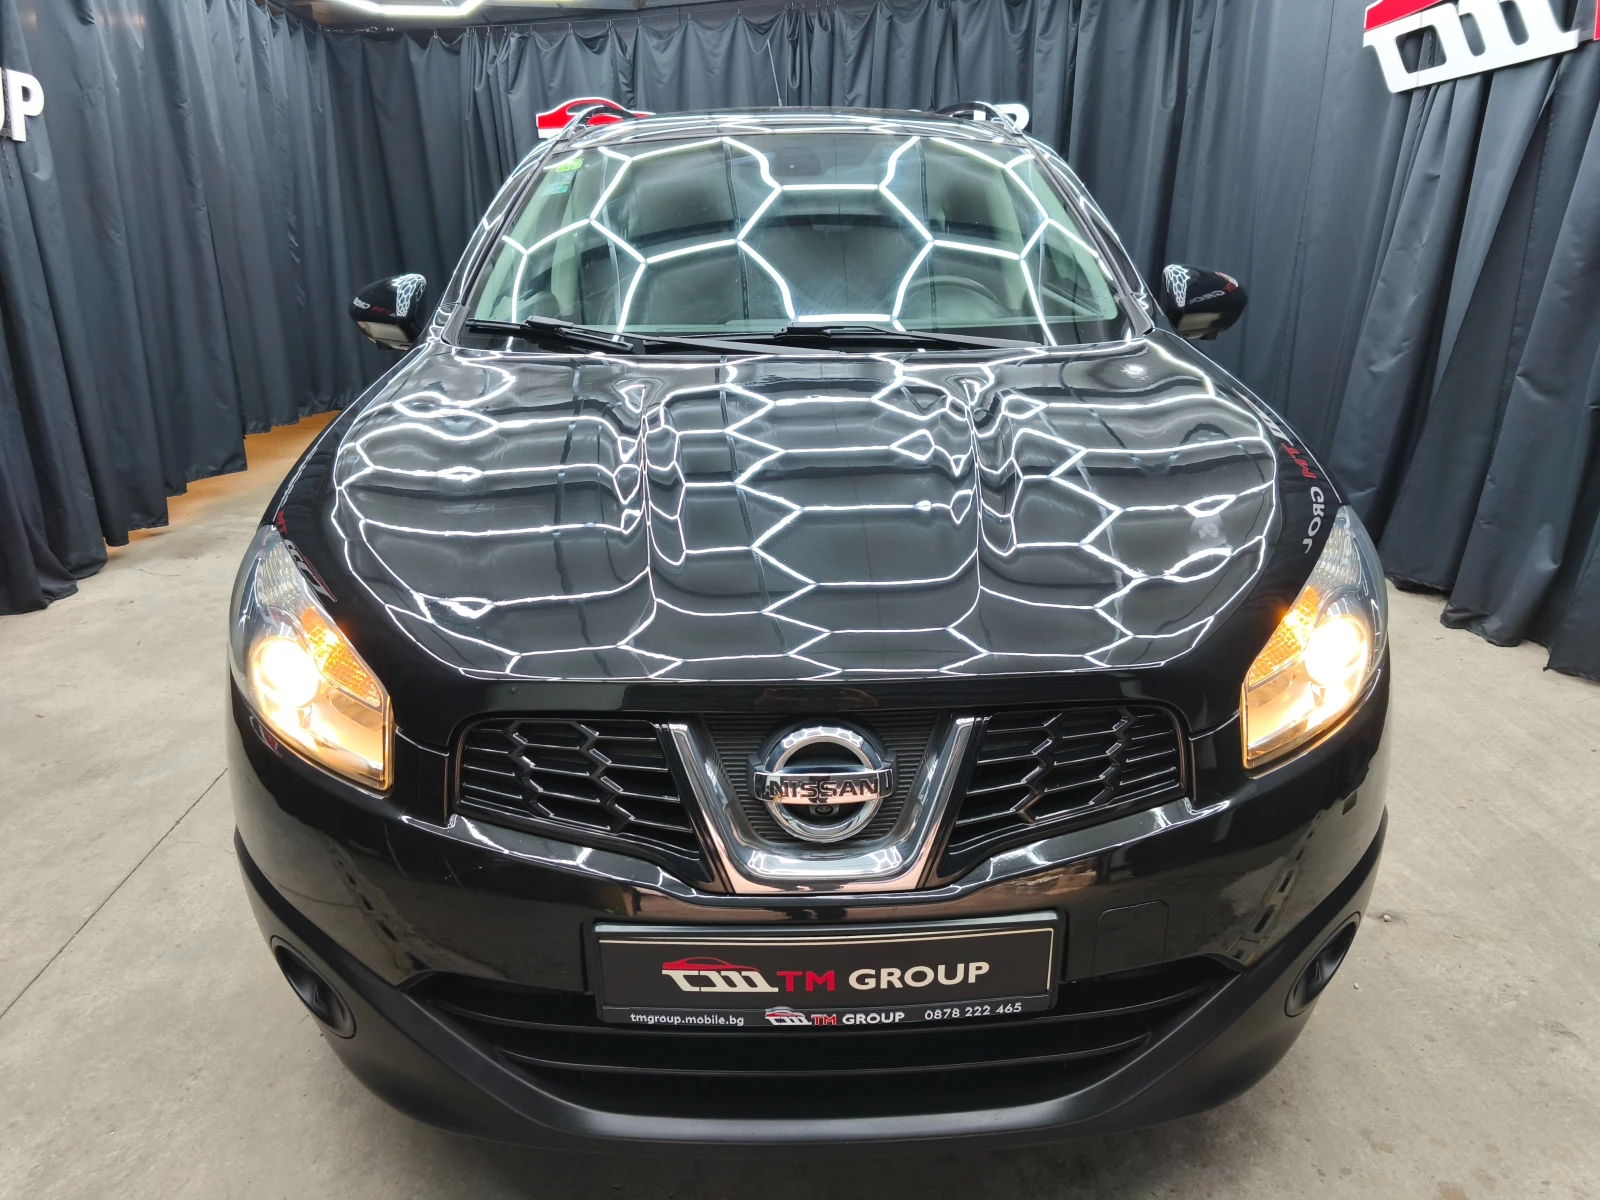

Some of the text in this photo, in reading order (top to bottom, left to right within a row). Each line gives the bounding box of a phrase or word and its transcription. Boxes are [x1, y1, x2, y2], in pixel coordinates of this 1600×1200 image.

[768, 779, 879, 799] NISSAN
[776, 970, 835, 992] TM
[848, 961, 990, 991] GROUP
[630, 1013, 744, 1026] tmgroup.mobile.bg
[811, 1014, 836, 1026] TM
[842, 1011, 905, 1025] GROUP
[924, 1002, 1022, 1021] 0878 222 465
